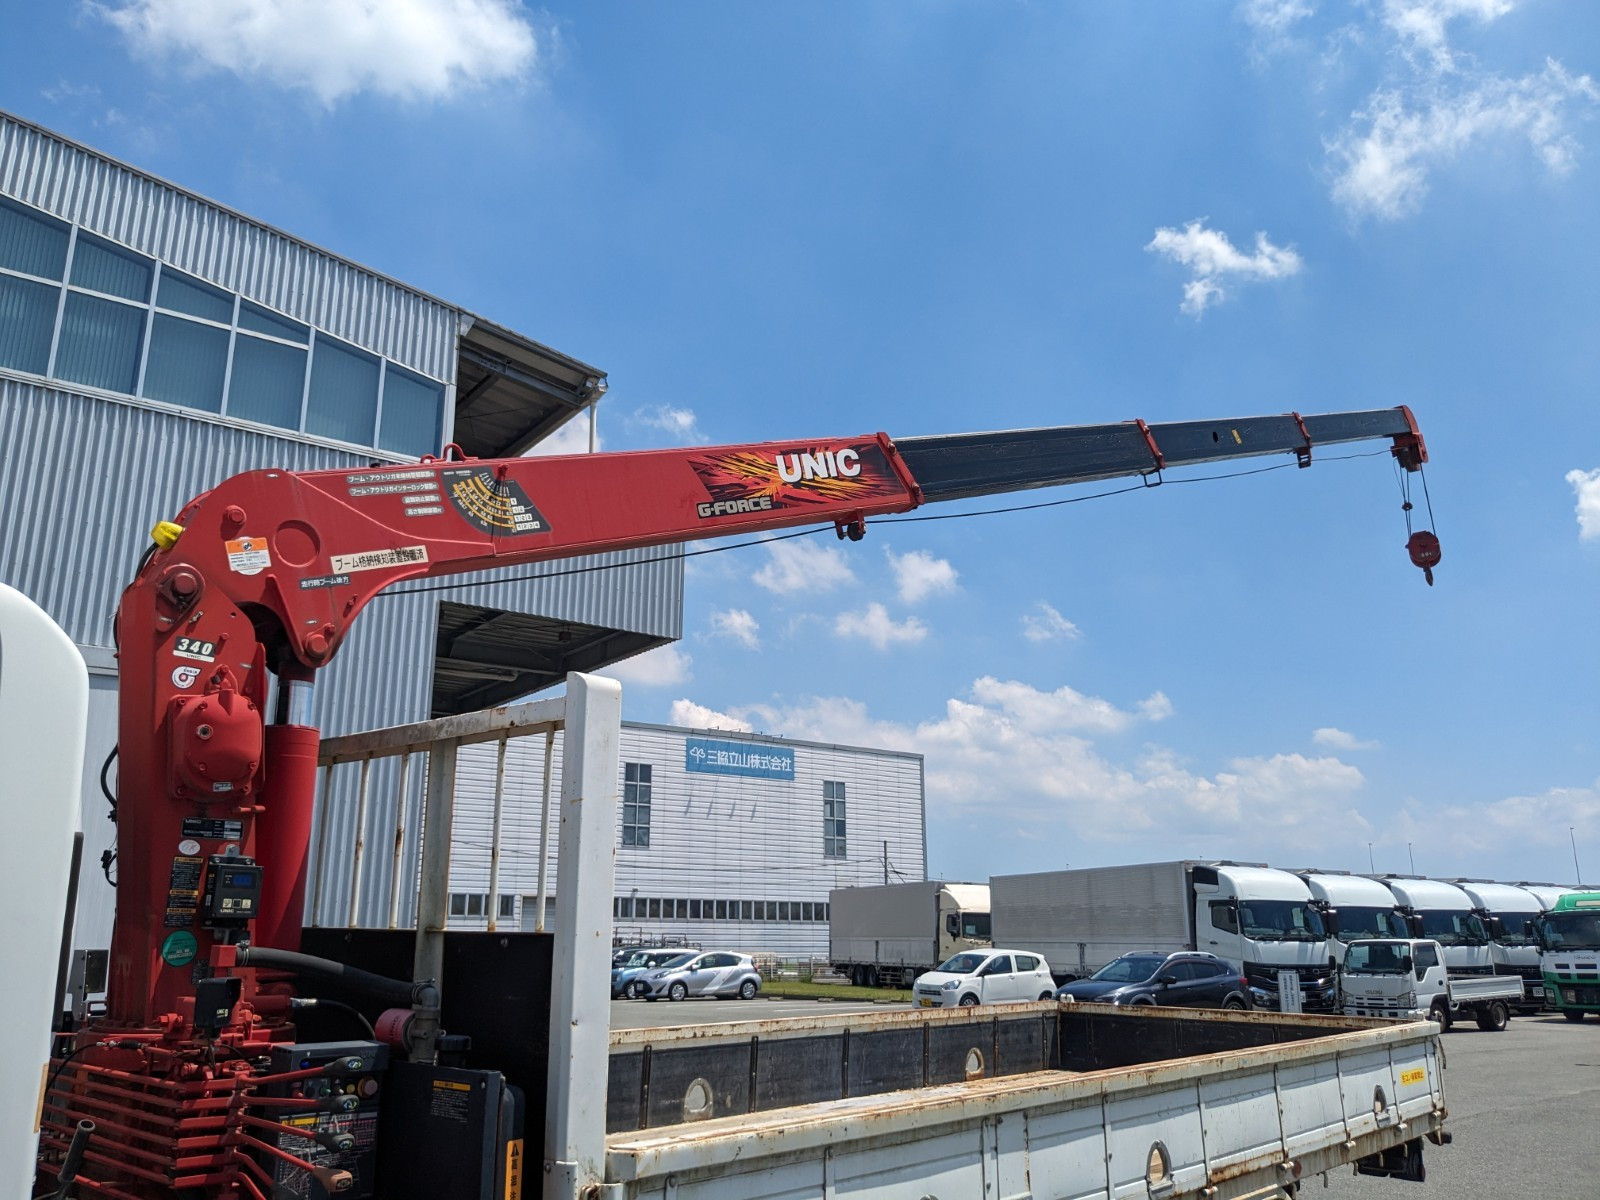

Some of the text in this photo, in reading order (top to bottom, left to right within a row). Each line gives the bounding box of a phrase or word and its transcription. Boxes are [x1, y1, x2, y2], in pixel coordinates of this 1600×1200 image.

[775, 448, 861, 483] UNIC
[178, 638, 213, 655] 340
[706, 749, 792, 772] 三協立山株式会社
